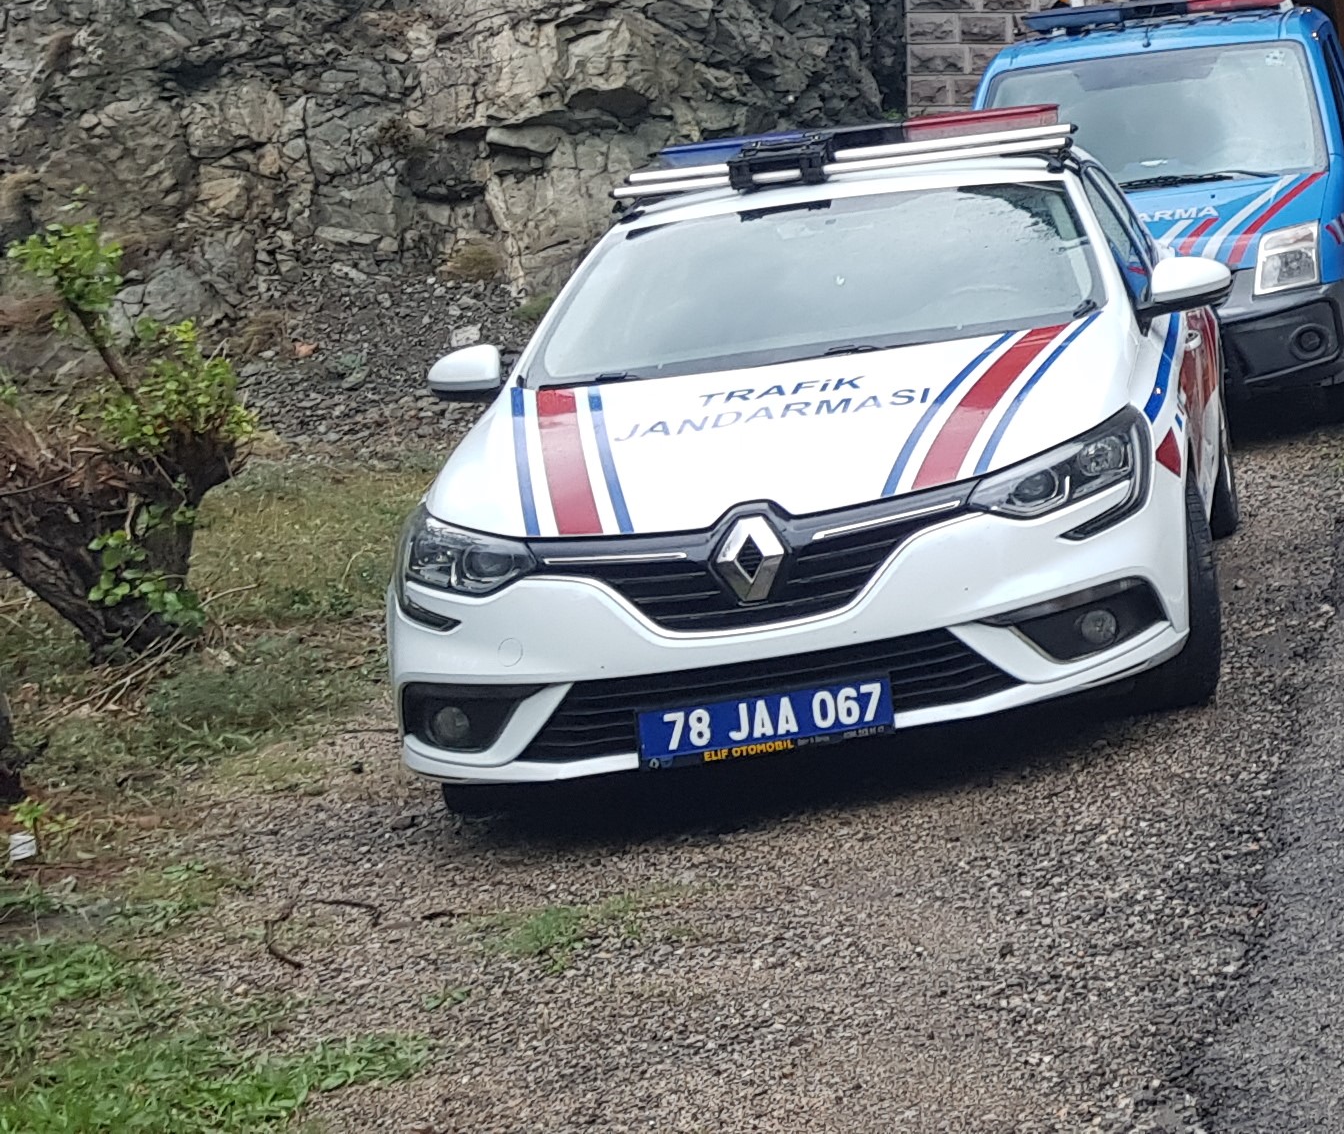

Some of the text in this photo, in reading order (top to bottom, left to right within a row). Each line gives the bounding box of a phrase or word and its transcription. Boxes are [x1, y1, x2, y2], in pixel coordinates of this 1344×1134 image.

[614, 387, 930, 442] JANDARMASI
[663, 682, 882, 751] 78 JAA 067
